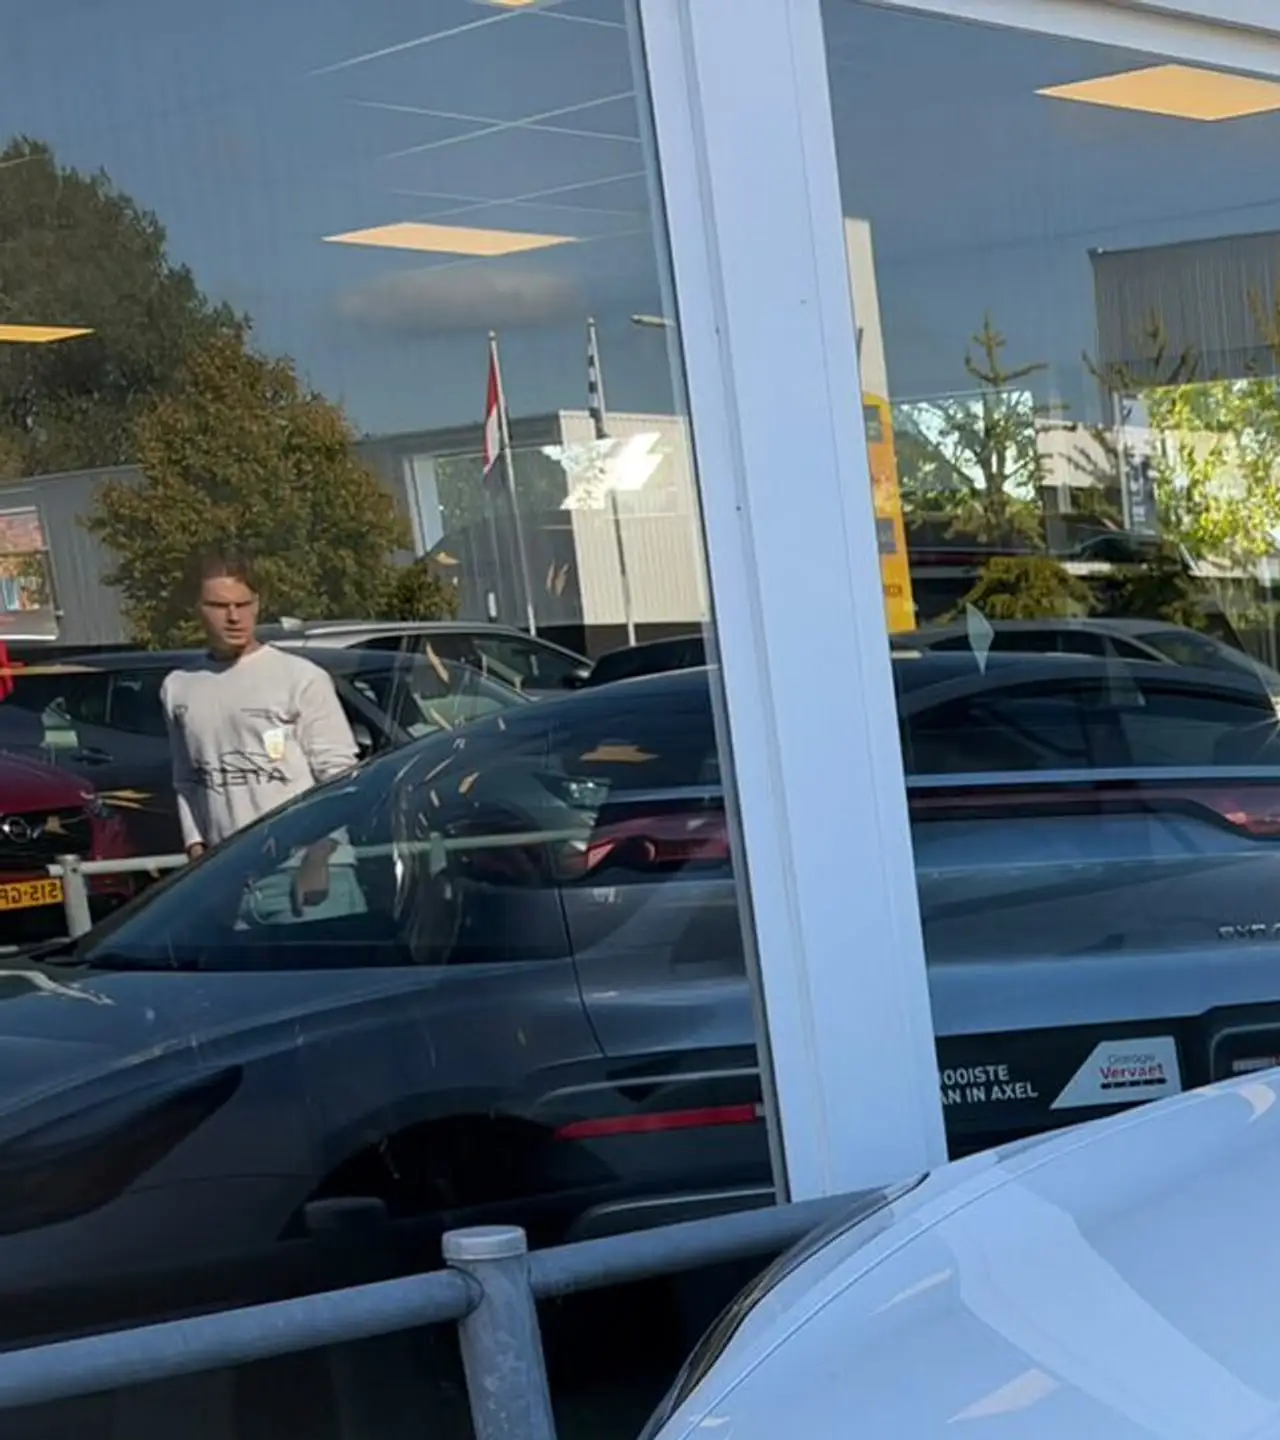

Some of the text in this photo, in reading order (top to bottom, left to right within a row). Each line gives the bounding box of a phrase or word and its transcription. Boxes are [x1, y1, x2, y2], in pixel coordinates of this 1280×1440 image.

[941, 1064, 1009, 1087] OOISTE
[1099, 1061, 1166, 1081] Vervaet
[965, 1086, 986, 1105] IN
[990, 1081, 1039, 1102] AXEL
